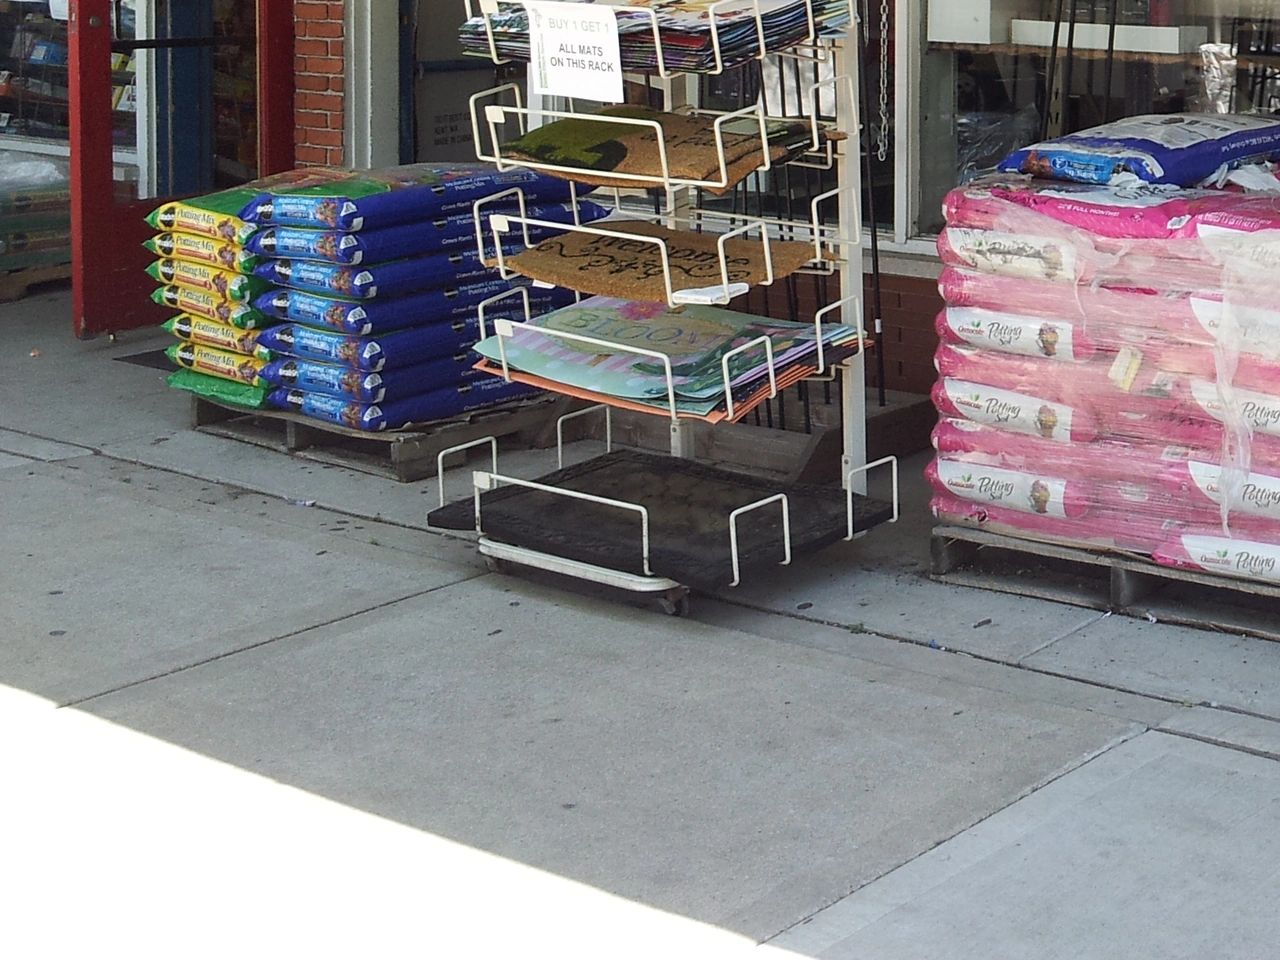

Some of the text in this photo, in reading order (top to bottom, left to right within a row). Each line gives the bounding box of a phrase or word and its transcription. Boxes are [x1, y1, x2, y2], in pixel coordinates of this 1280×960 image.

[549, 18, 570, 30] BUY
[581, 20, 602, 32] GET
[559, 43, 604, 57] ALL MATS
[550, 56, 615, 73] ON THIS RACK
[988, 322, 1022, 340] Potting
[985, 398, 1021, 419] Potting
[1242, 401, 1280, 423] Potting
[978, 476, 1014, 497] Potting
[1235, 551, 1276, 572] Potting
